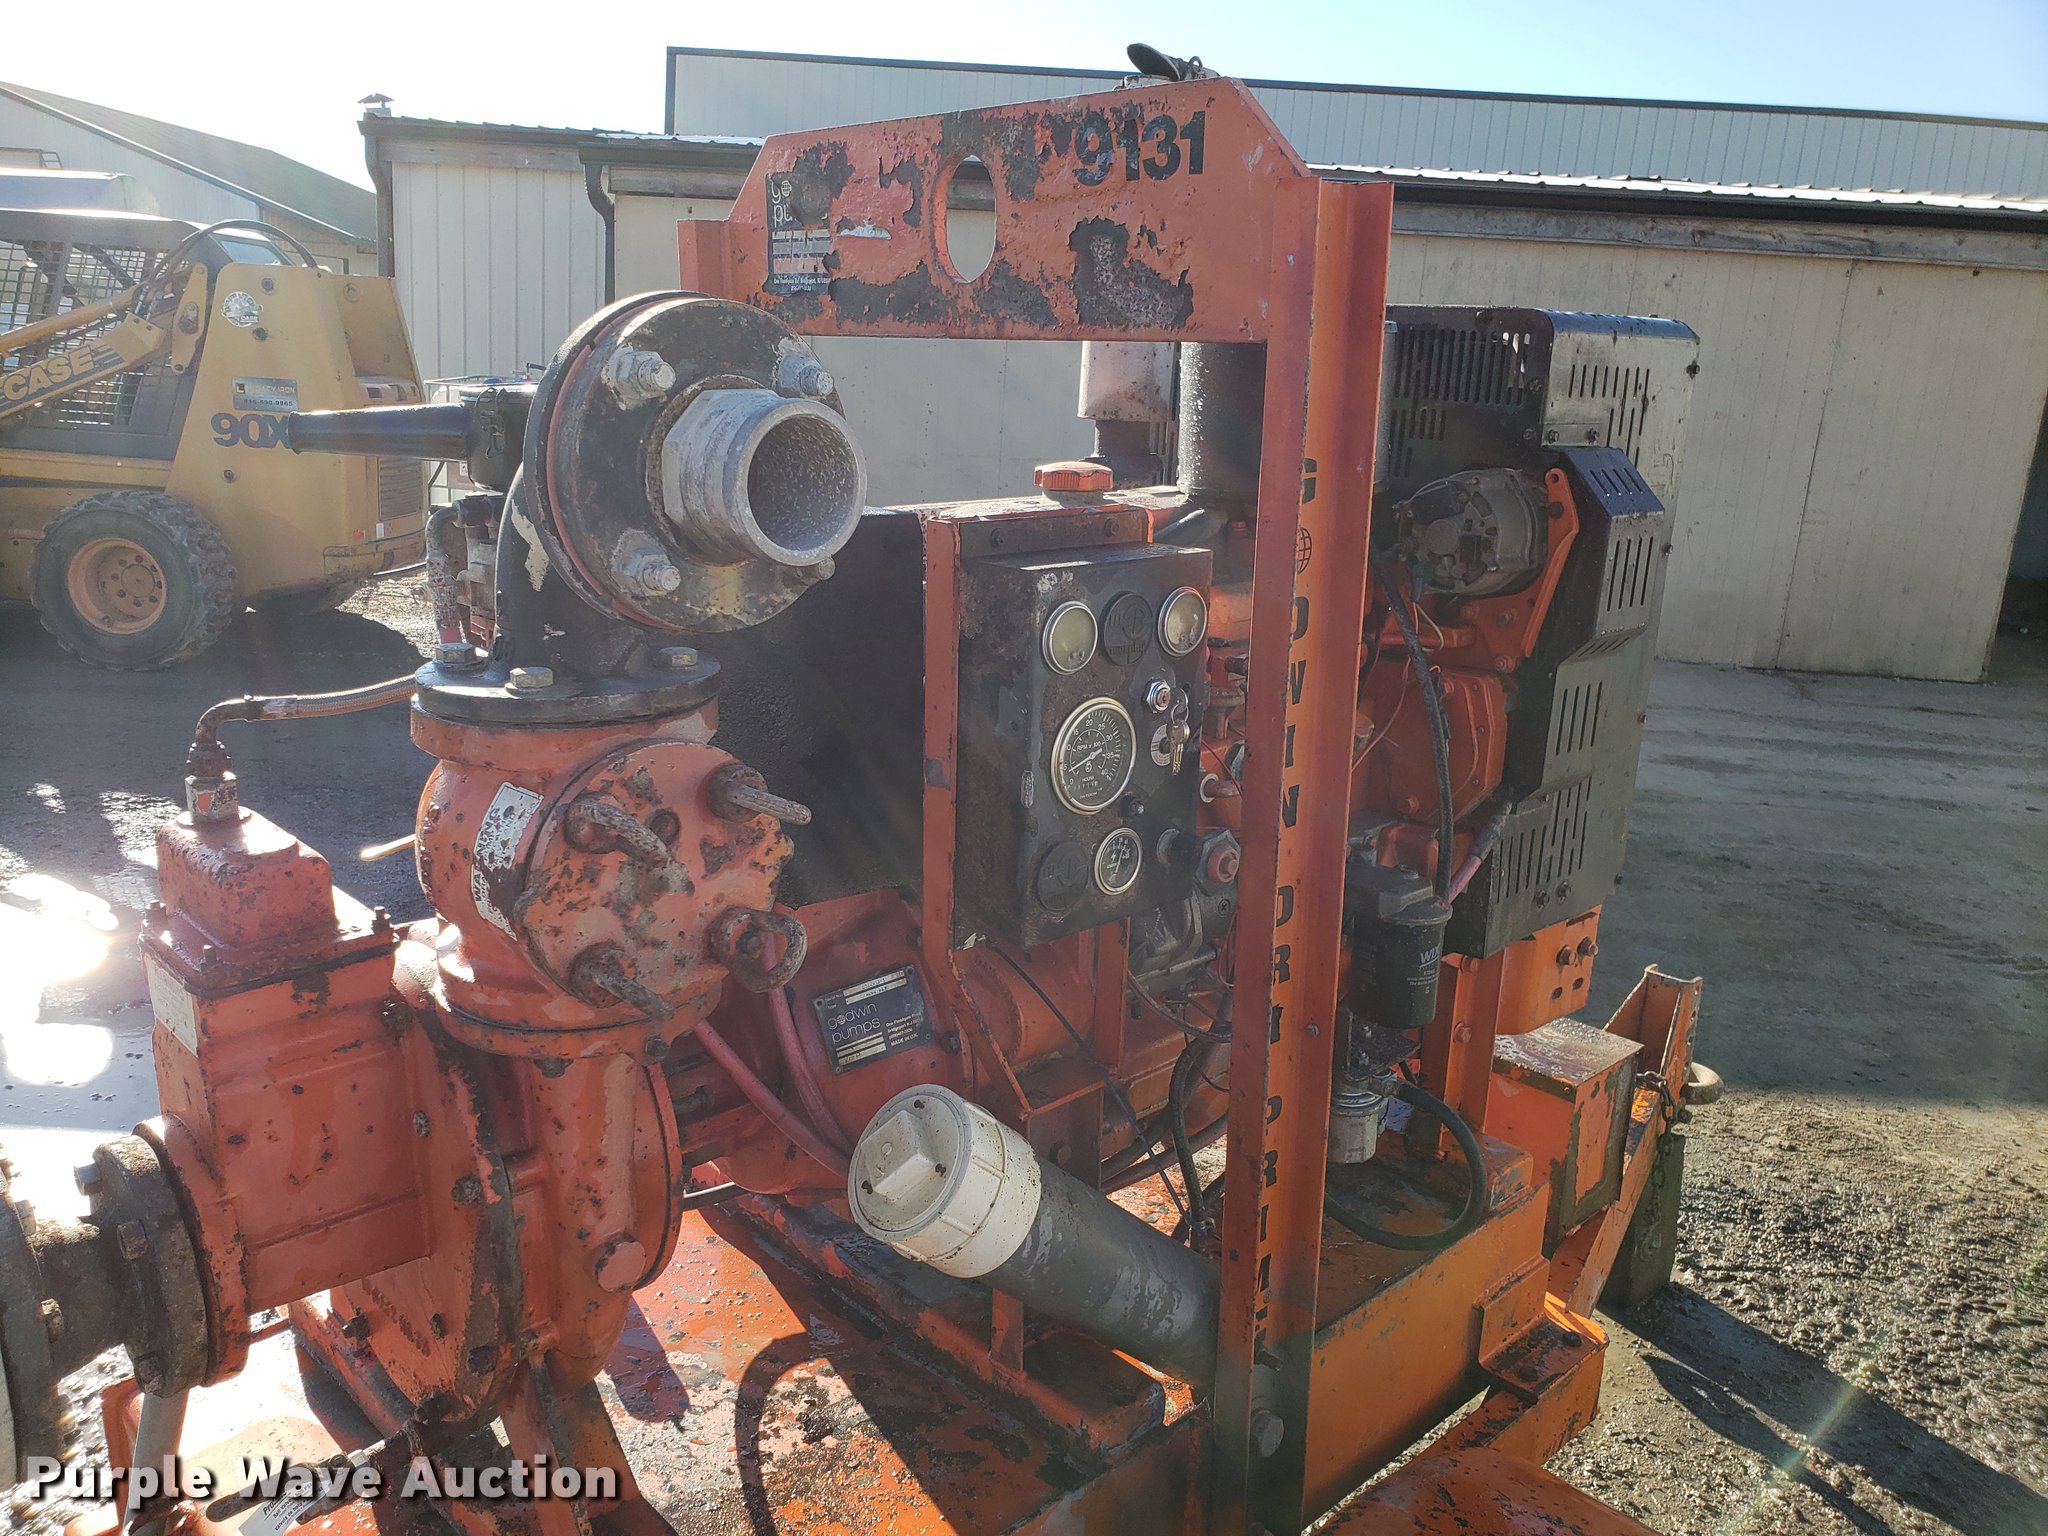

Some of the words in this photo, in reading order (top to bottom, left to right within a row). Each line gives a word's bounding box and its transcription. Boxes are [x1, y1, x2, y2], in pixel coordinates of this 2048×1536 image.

[1074, 110, 1205, 187] 9131
[3, 345, 95, 402] CASE
[828, 1003, 877, 1030] godwin
[832, 1018, 881, 1045] pumps
